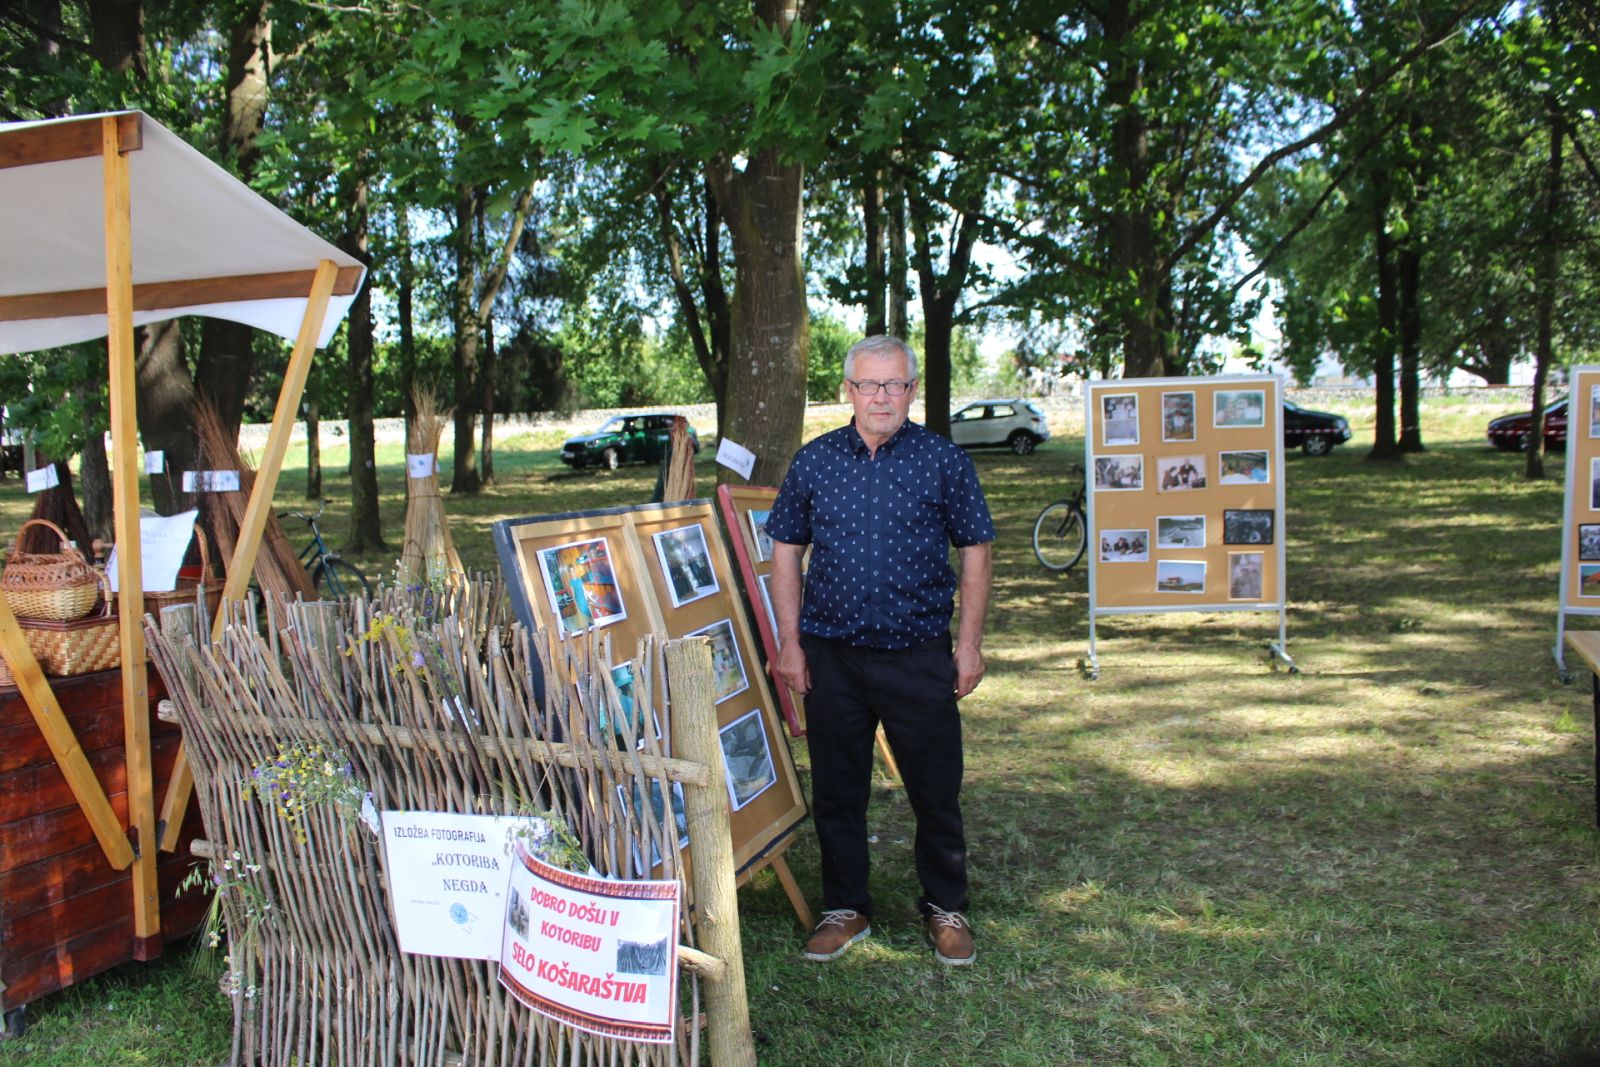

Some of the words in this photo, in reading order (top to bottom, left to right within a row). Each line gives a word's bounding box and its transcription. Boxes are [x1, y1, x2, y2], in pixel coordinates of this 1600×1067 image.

[394, 825, 429, 839] IZLOŽBA
[431, 829, 486, 843] FOTOGRAFIJA
[442, 878, 489, 894] NEGDA
[530, 886, 566, 914] DOBRO
[568, 901, 607, 925] DOŠLI
[610, 910, 620, 927] V
[540, 920, 602, 952] KOTORIBU
[512, 942, 536, 972] SELO
[537, 960, 647, 1004] KOŠARAŠTVA
